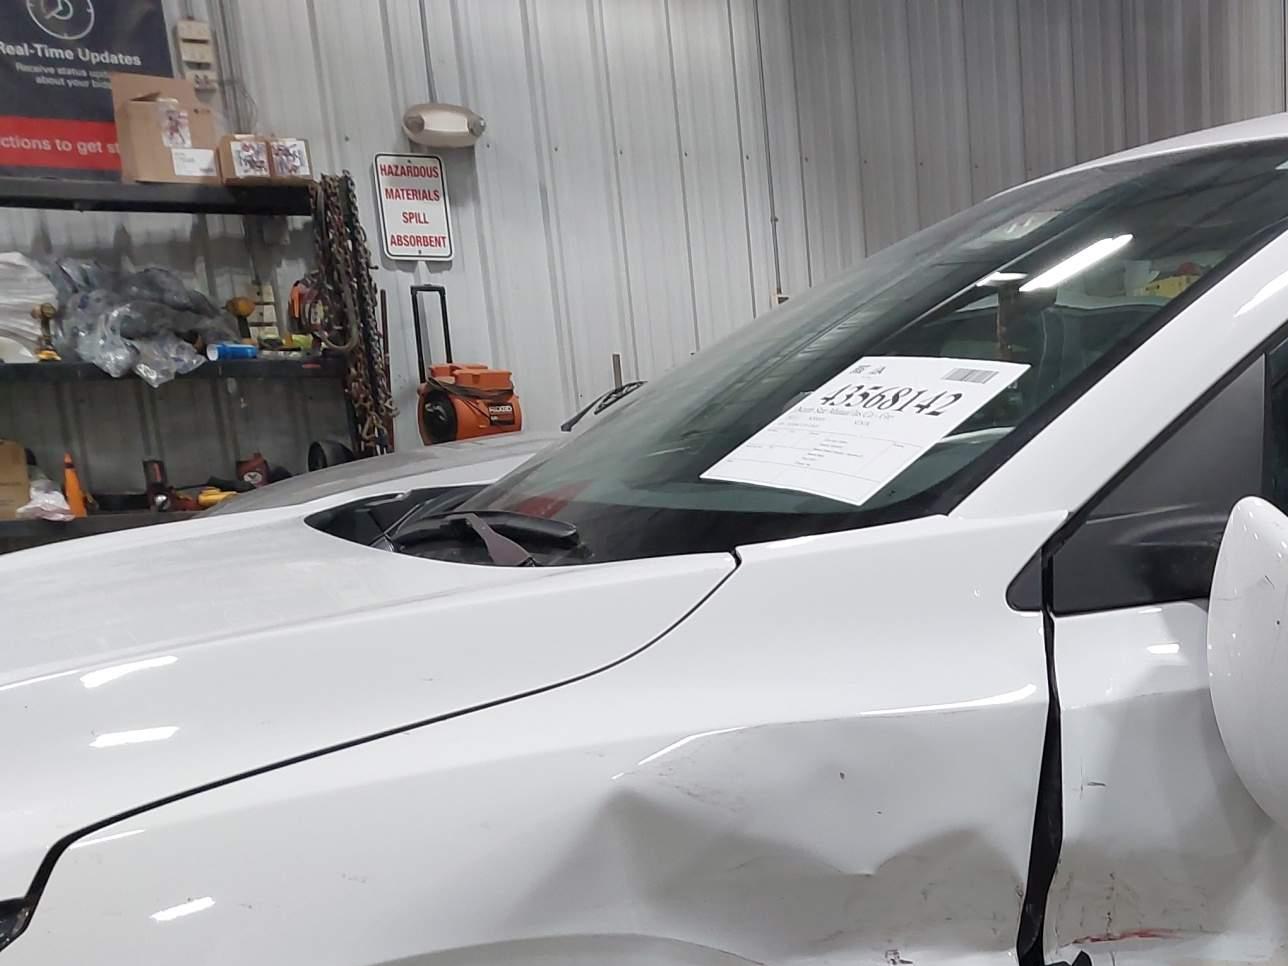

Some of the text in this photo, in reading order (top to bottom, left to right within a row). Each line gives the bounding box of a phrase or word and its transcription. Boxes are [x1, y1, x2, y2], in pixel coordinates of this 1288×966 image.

[0, 41, 142, 66] Real-Time Updates
[36, 76, 65, 86] about
[55, 139, 72, 151] to
[77, 141, 102, 155] get
[379, 164, 439, 178] HAZARDOUS
[385, 188, 440, 201] MATERIALS
[402, 211, 429, 224] SPILL
[390, 234, 446, 248] ABSORBENT
[820, 383, 963, 416] 43568142
